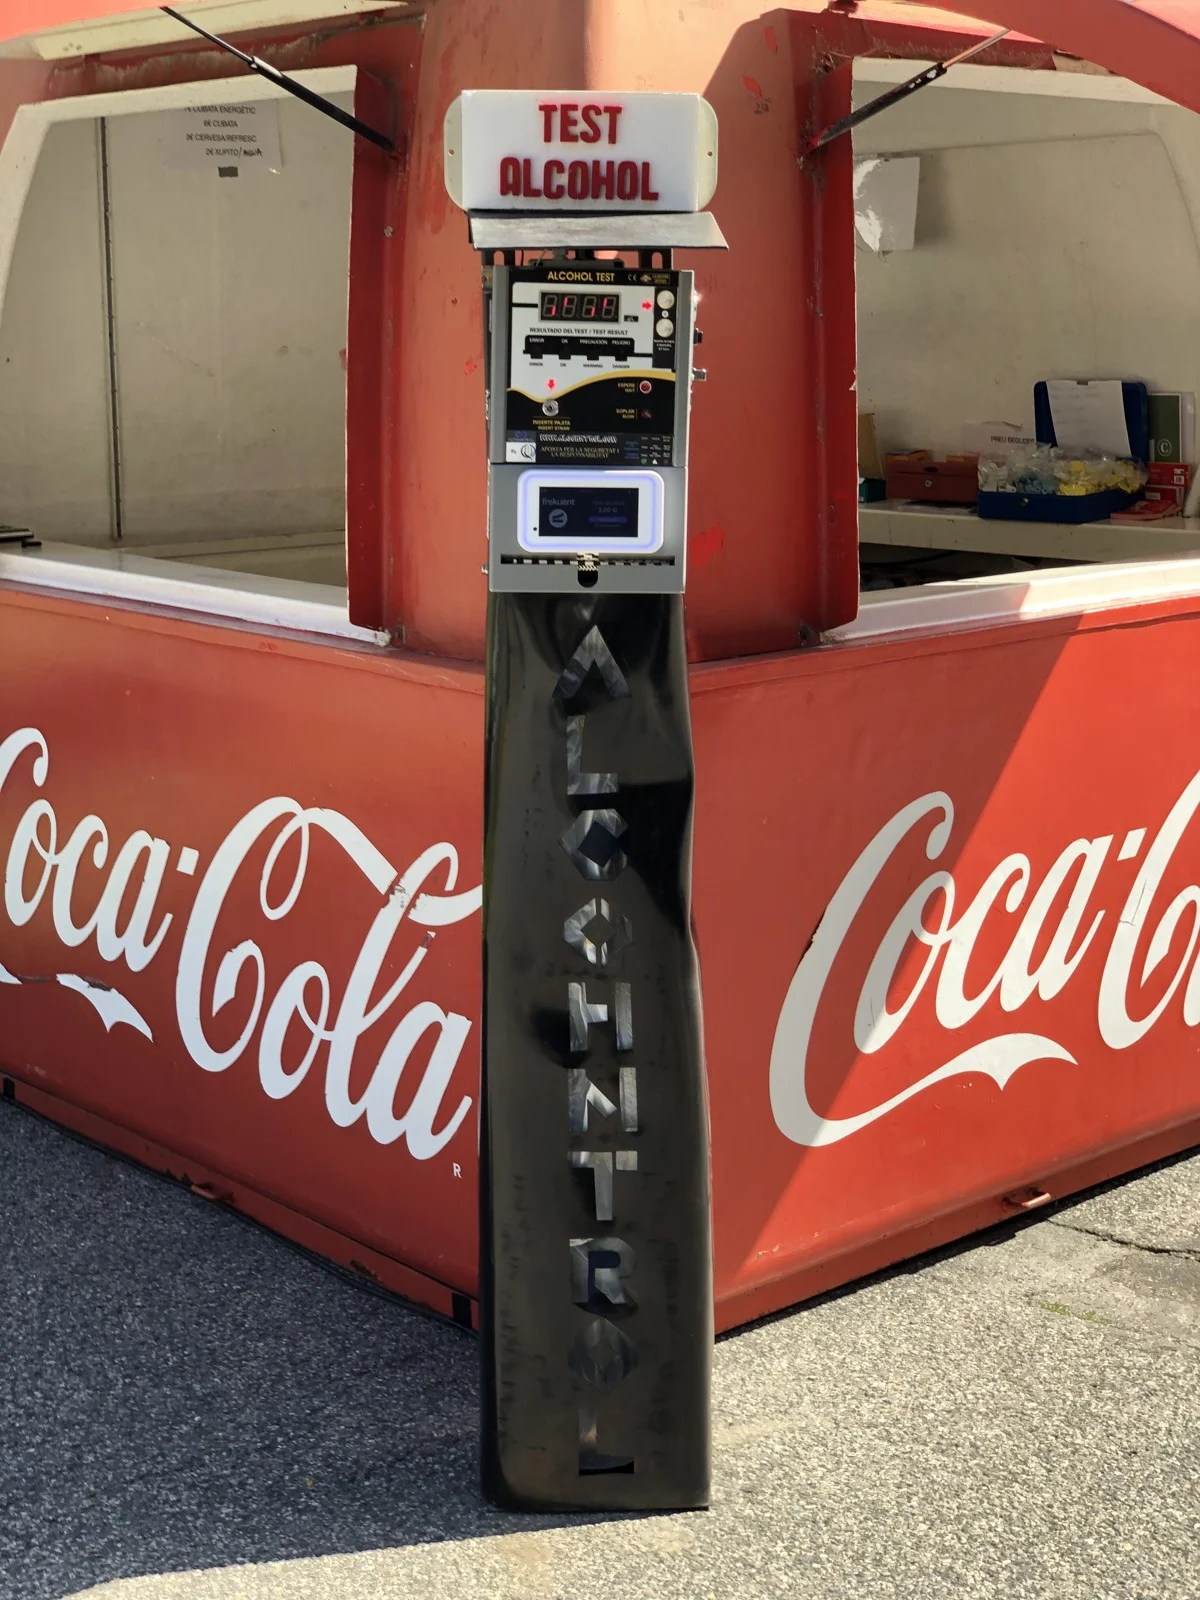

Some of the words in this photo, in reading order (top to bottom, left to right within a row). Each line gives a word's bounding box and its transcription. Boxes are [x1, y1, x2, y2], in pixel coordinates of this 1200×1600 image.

[192, 105, 219, 114] CUBATA
[212, 119, 239, 128] CUBATA
[538, 103, 623, 144] TEST
[185, 133, 194, 142] 3€
[499, 156, 660, 201] ALCOHOL
[547, 270, 594, 282] ALCOHOL
[596, 272, 616, 282] TEST
[541, 497, 575, 506] frekuent
